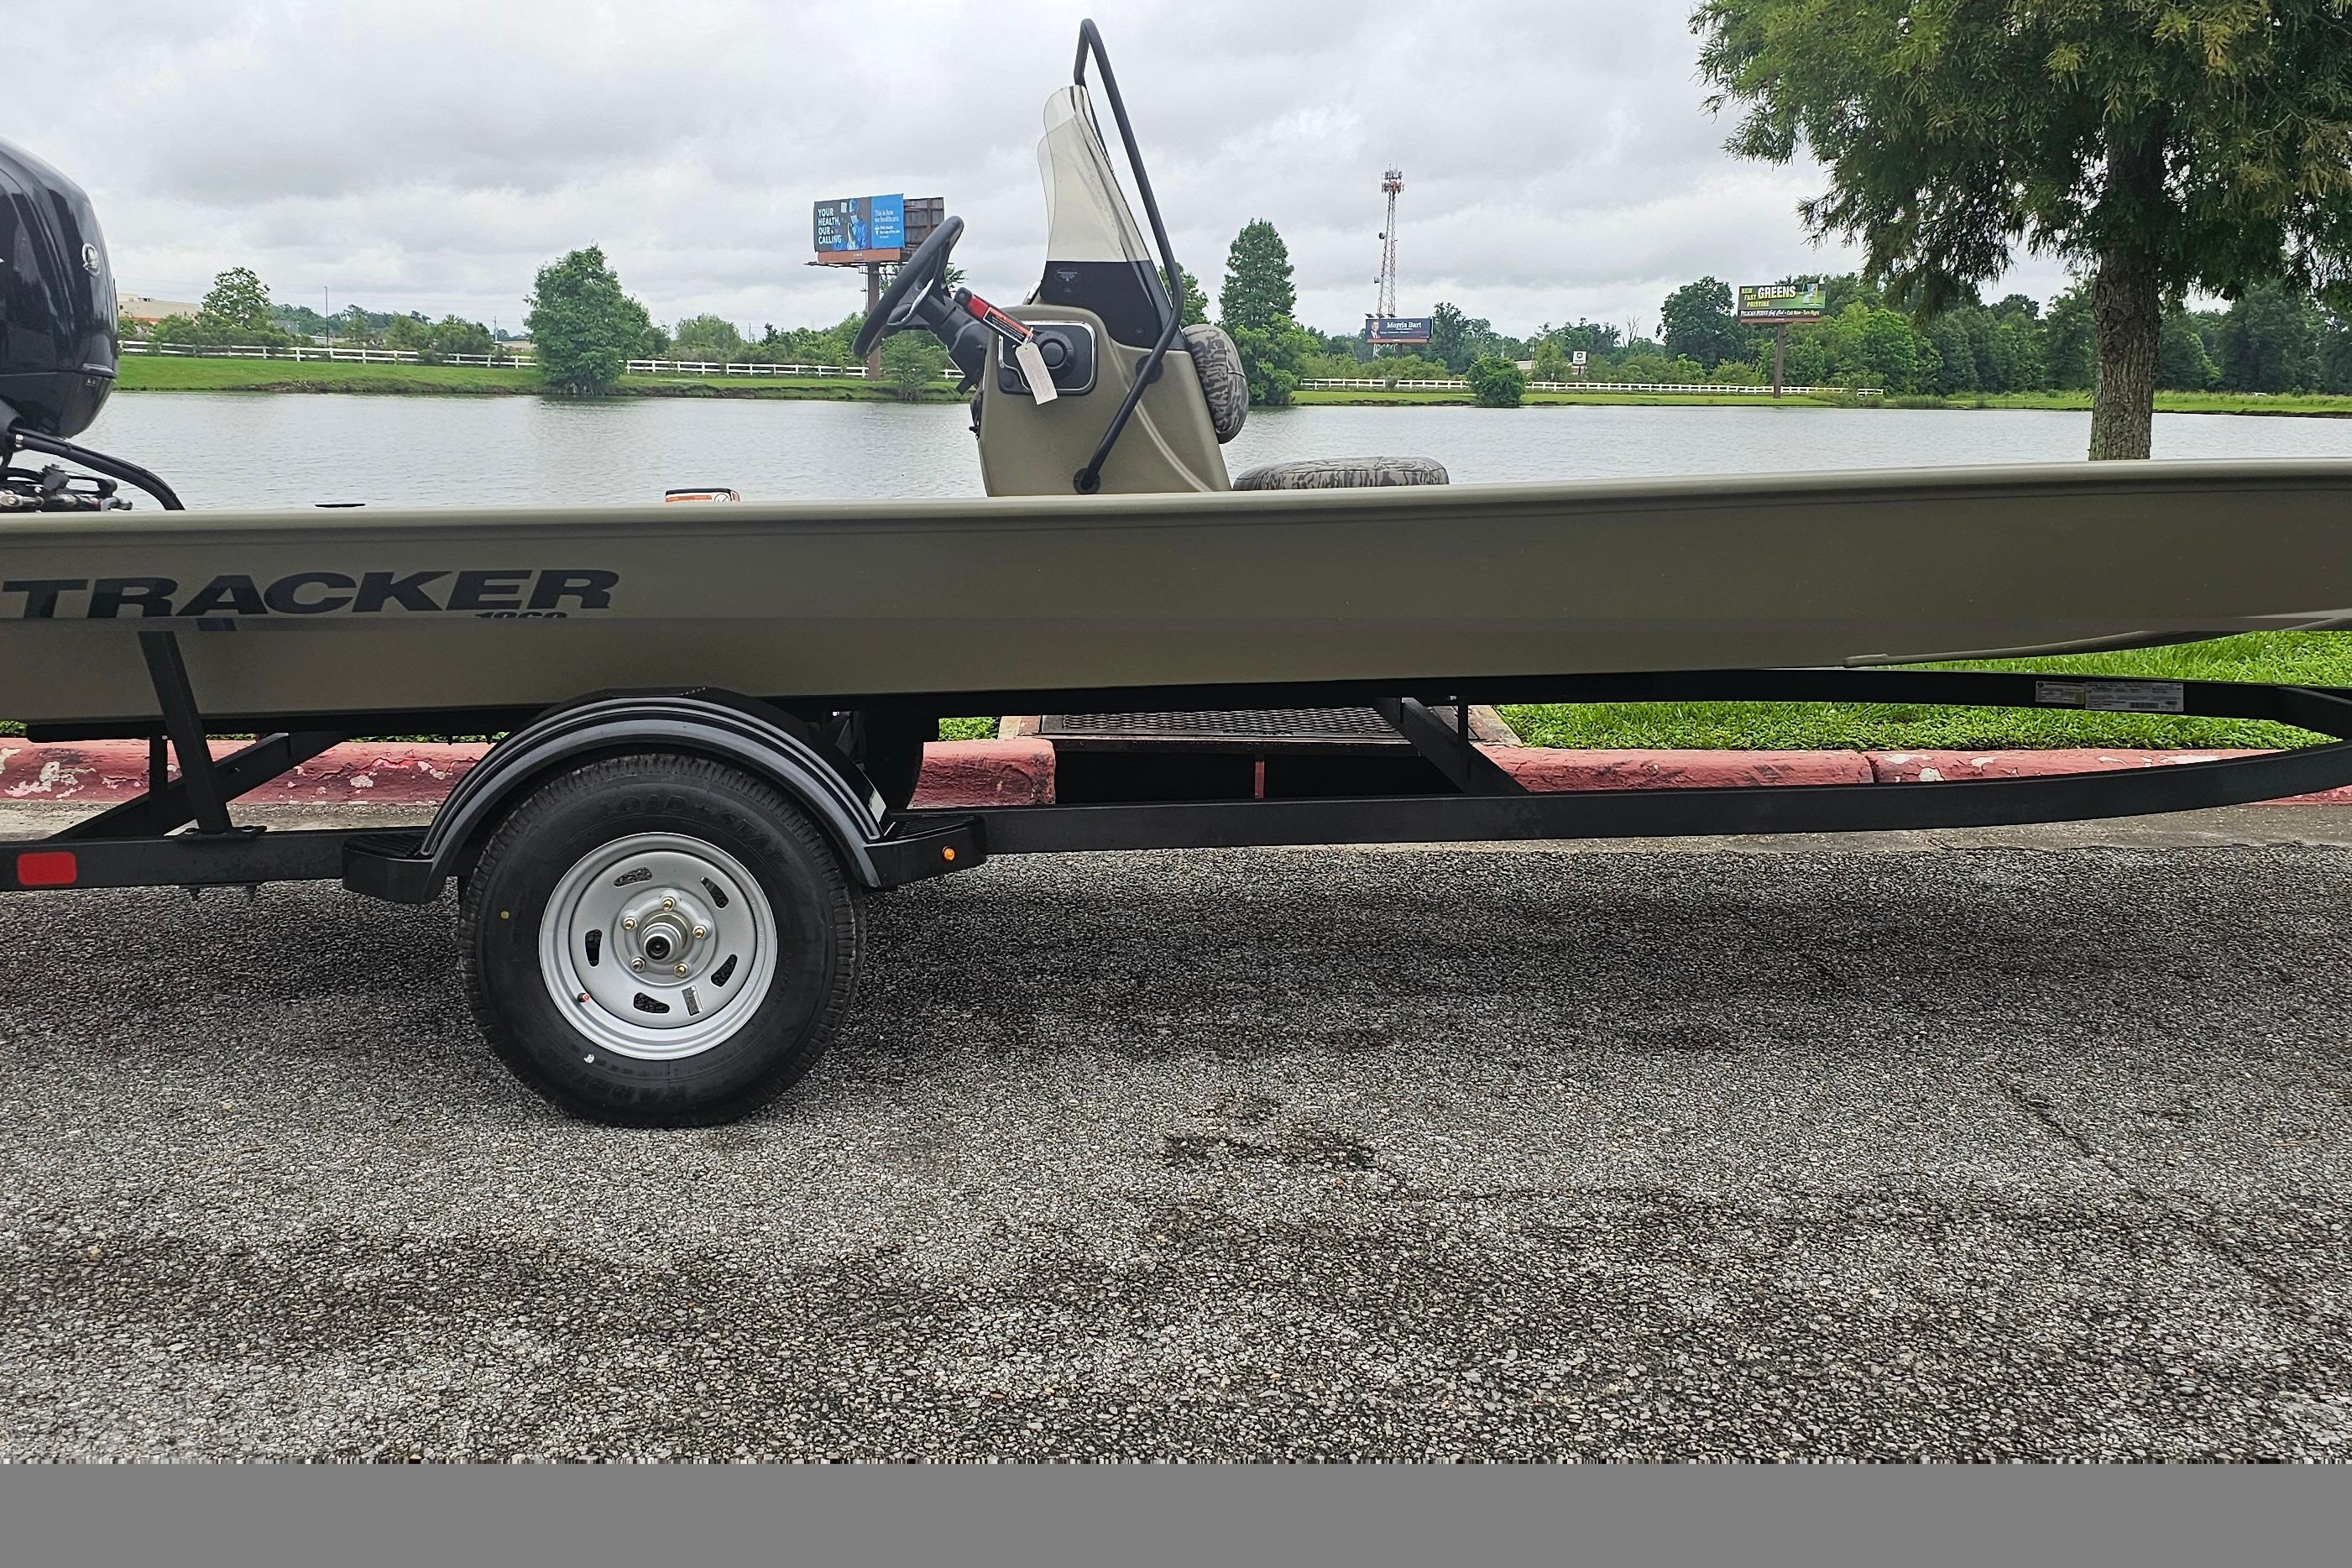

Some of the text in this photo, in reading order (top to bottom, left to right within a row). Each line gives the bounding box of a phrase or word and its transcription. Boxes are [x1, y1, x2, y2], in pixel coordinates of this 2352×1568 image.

[818, 208, 834, 217] YOUR
[818, 217, 840, 227] HEALTH,
[818, 235, 842, 244] CALLING
[1758, 285, 1796, 300] GREENS
[2, 569, 619, 618] TRACKER
